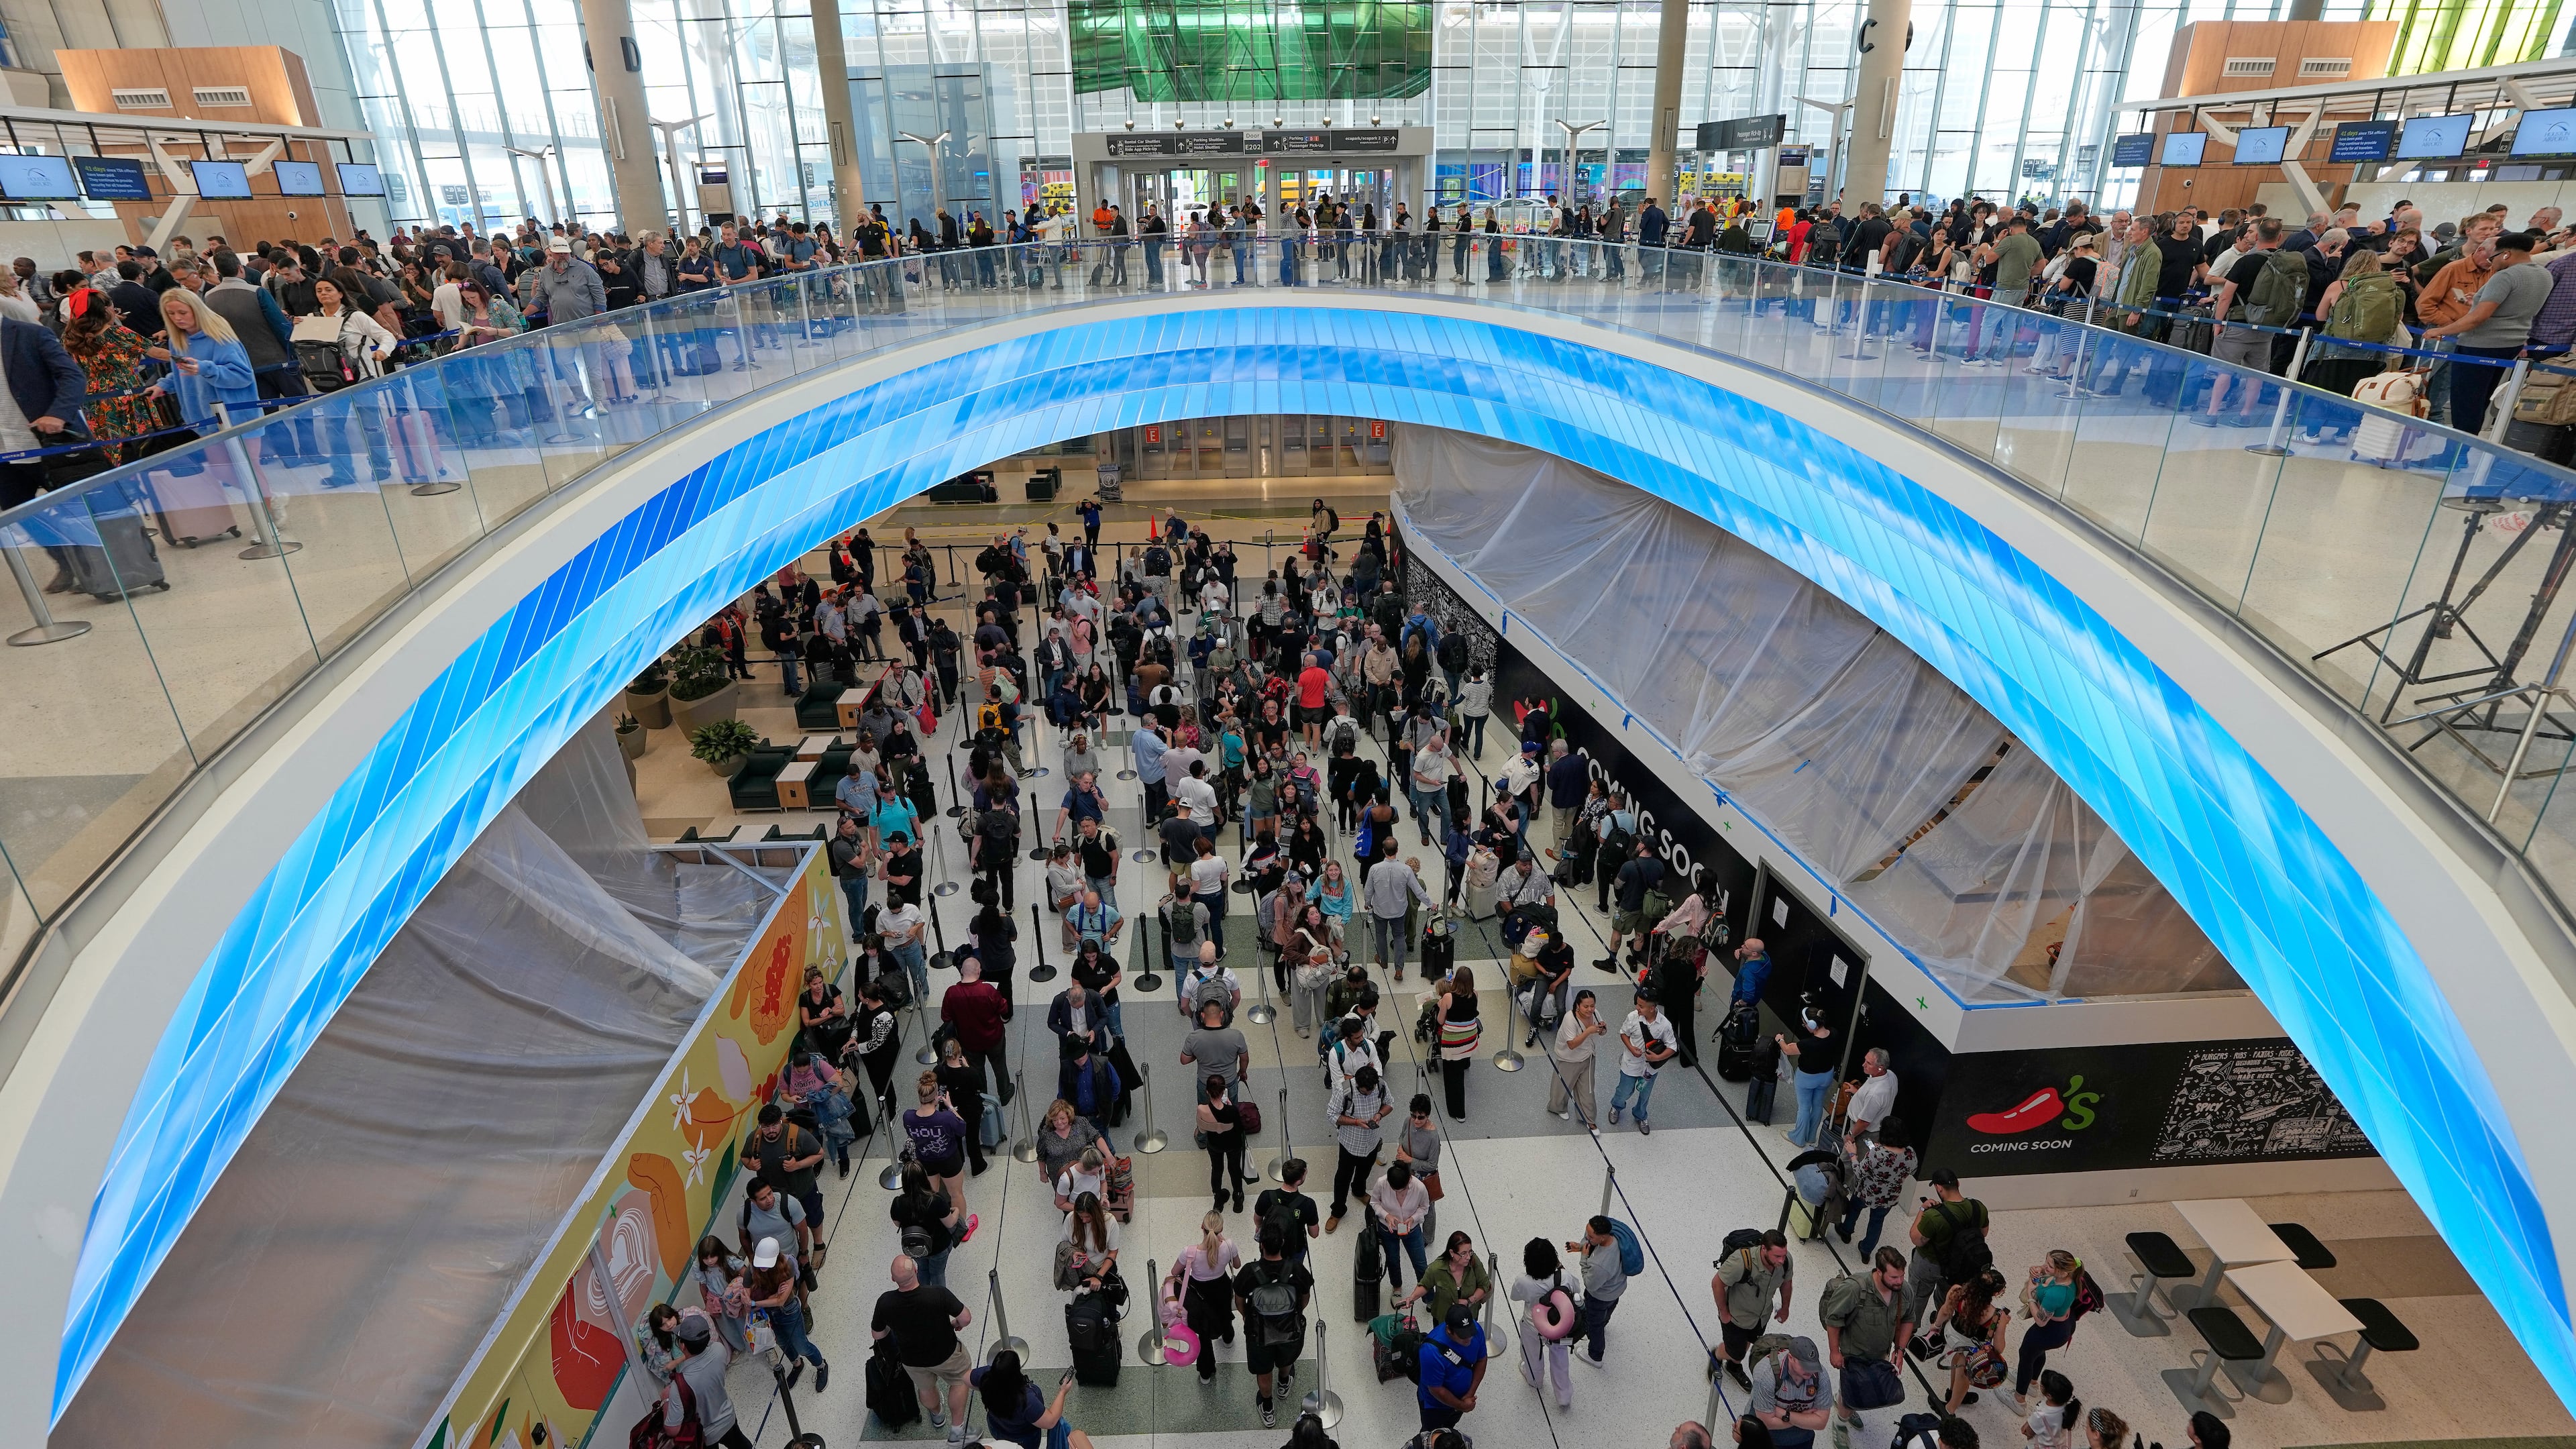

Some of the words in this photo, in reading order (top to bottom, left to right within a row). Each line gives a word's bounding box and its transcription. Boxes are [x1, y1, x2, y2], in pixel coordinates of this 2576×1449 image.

[1858, 19, 1878, 53] C
[620, 36, 642, 72] D
[1150, 431, 1156, 441] E
[1375, 425, 1381, 436] E
[2201, 1053, 2229, 1061] BURGERS
[2194, 1102, 2224, 1113] SPICY
[1970, 1142, 2029, 1153] COMING
[2031, 1140, 2073, 1150] SOON
